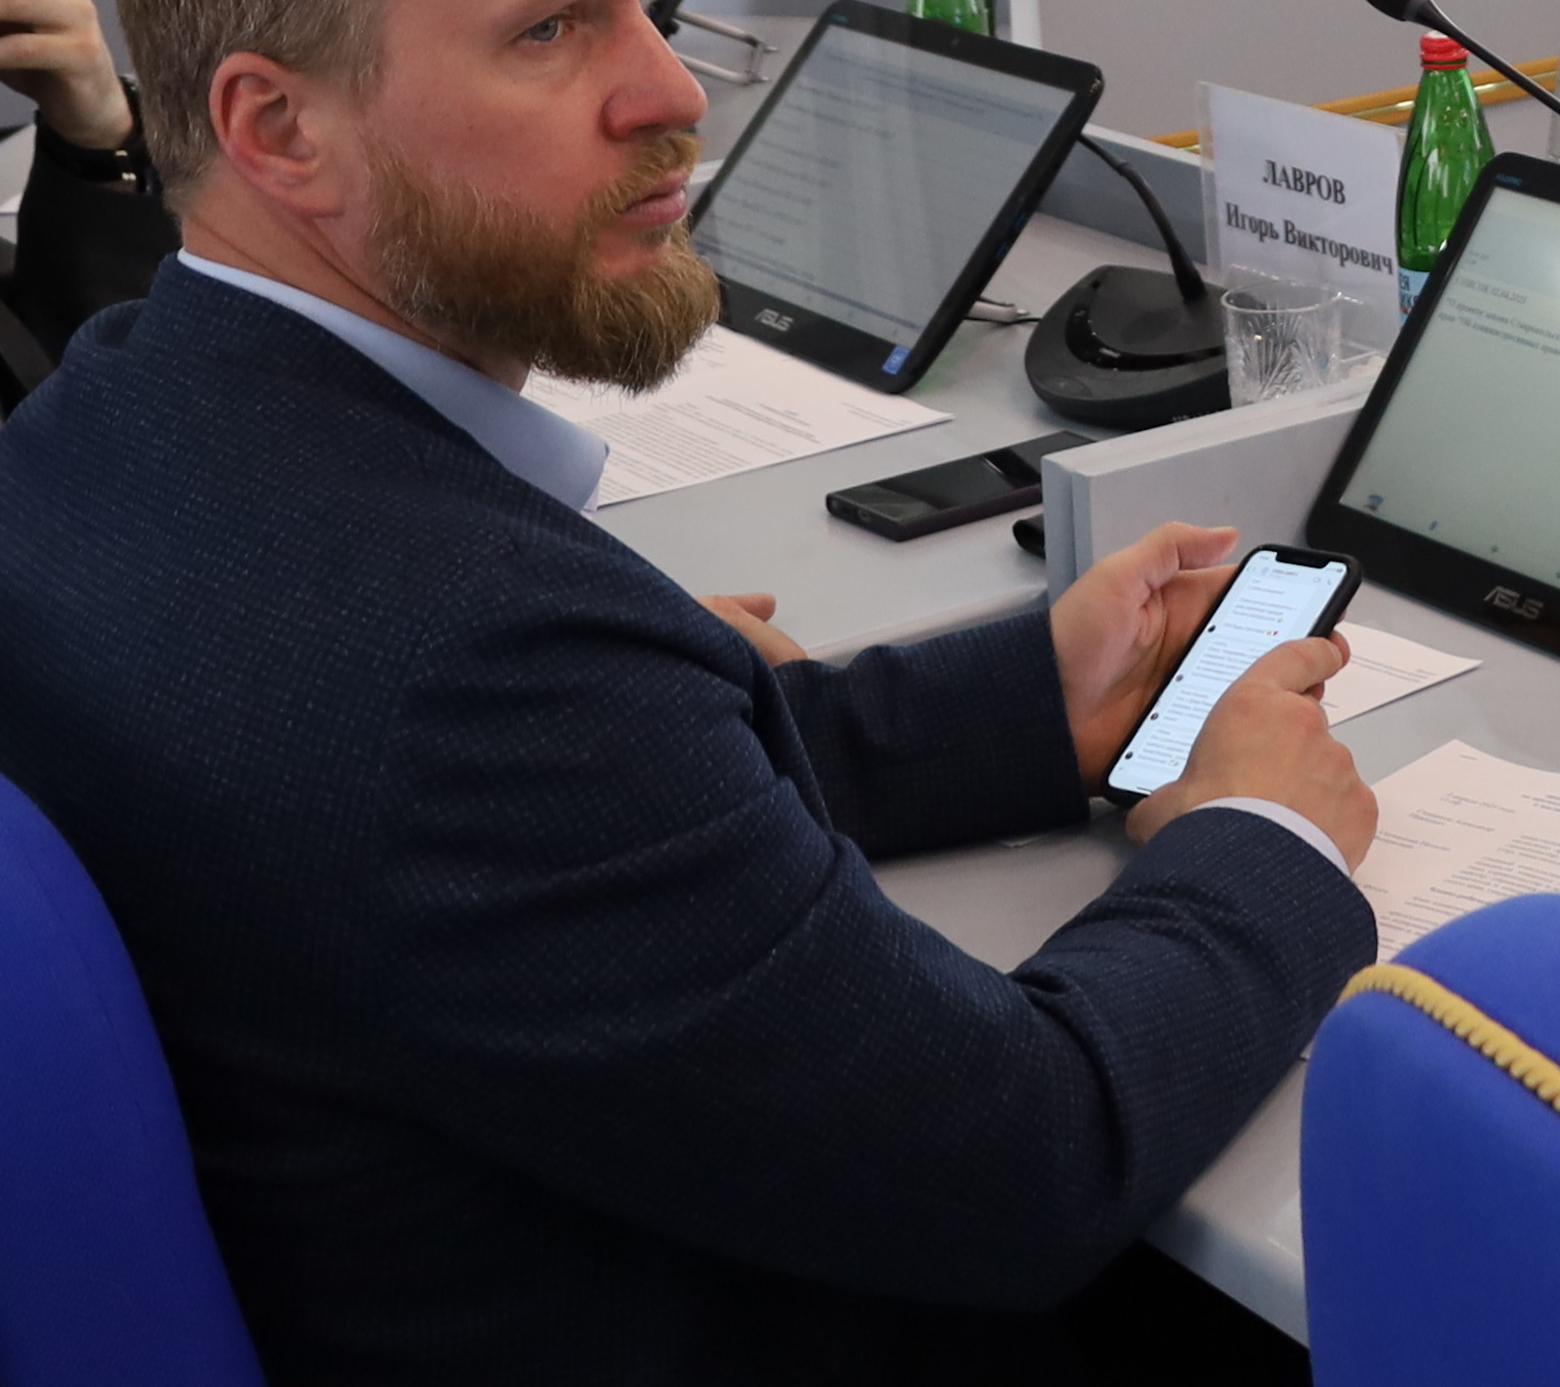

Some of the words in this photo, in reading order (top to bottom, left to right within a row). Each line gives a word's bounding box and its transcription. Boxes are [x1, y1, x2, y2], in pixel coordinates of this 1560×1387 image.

[1262, 159, 1347, 205] ЛАВРОВ
[1225, 201, 1280, 243] Игорь
[1283, 218, 1394, 276] Викторович
[1484, 585, 1544, 620] ASUS
